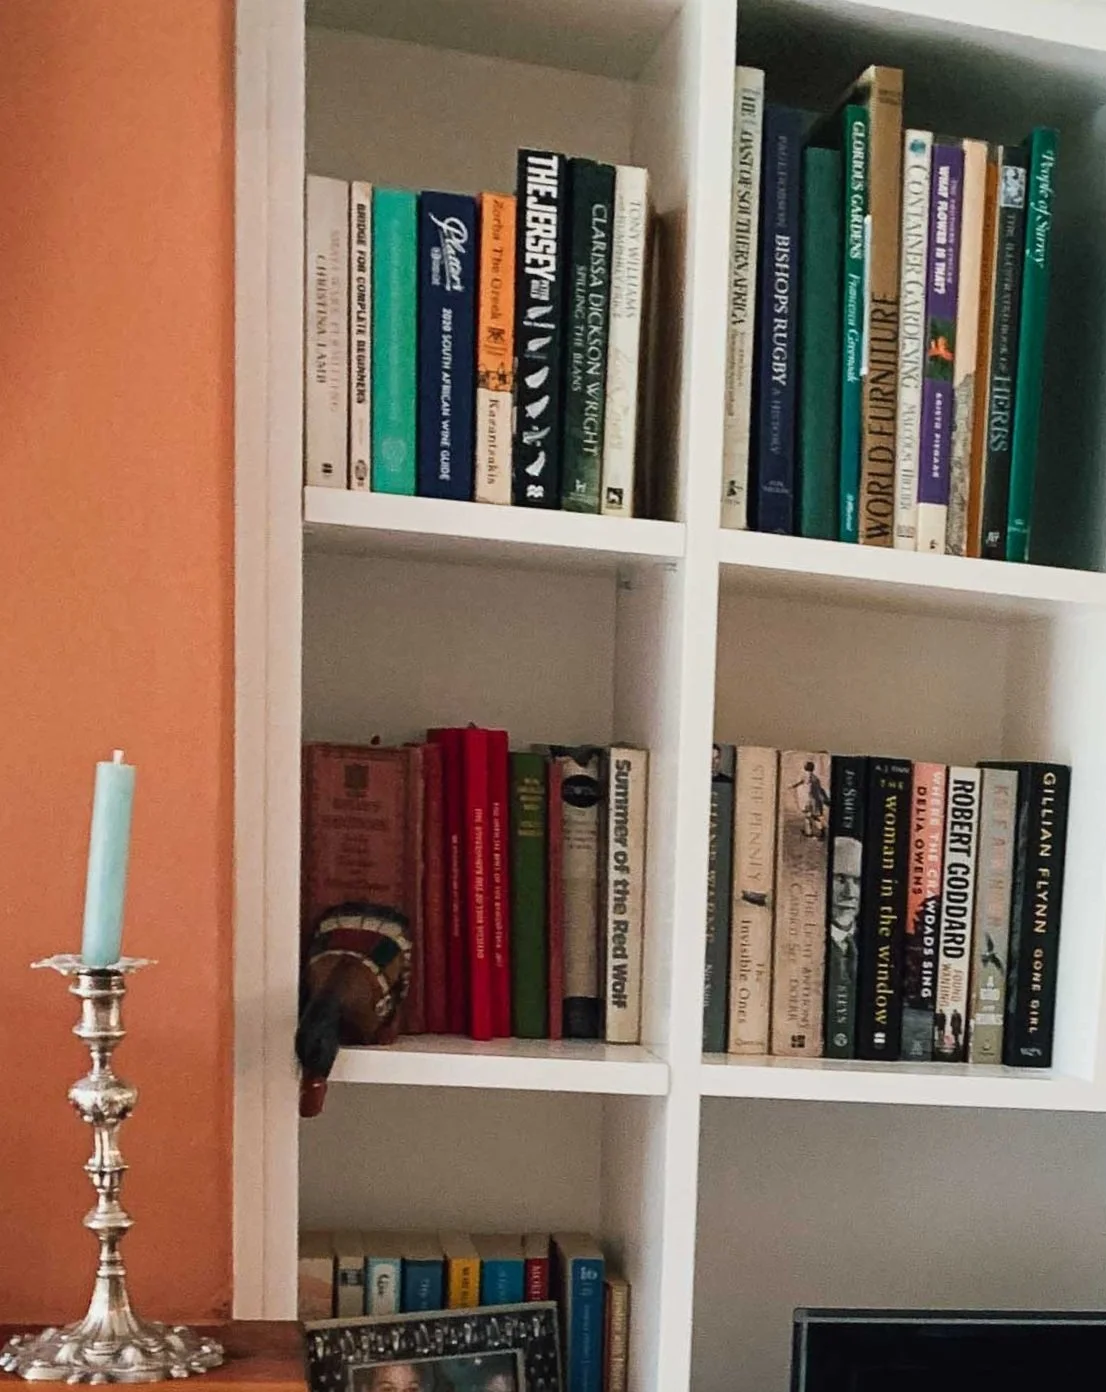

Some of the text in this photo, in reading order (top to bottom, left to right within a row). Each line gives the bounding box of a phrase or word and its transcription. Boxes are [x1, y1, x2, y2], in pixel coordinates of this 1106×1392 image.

[850, 120, 868, 191] GLORIOUS
[1025, 149, 1057, 268] People of Surrey
[489, 199, 506, 320] Zorba The Greek
[524, 154, 559, 283] THE JERSEY
[625, 202, 642, 319] TONY WILLIAMS
[735, 189, 756, 271] SOUTHERN
[772, 233, 791, 315] BISHOPS
[849, 193, 866, 260] GARDENS
[904, 164, 930, 276] CONTAINER
[933, 165, 950, 295] WHAT FLOWER IS THAT?
[356, 203, 366, 405] BRIDGE FOR COMPLETE BEGINNERS
[571, 264, 587, 393] SPILLING THE BEANS
[581, 203, 608, 458] CLARISSA DICKSON WRIGHT
[731, 272, 753, 325] AFRICA
[769, 318, 789, 386] RUGBY
[901, 280, 926, 389] GARDENING
[439, 308, 453, 481] 2020 SOUTH AFRICAN WINE GUIDE
[864, 291, 900, 541] WORLD FURNITURE
[989, 374, 1013, 452] HERBS
[842, 787, 856, 829] SMUTS
[911, 785, 928, 896] DELIA OWENS
[611, 759, 632, 1009] Summer of the Red Wolf
[873, 795, 900, 1025] woman in the window
[920, 771, 943, 999] WHERE THE CRAWDADS SING
[942, 779, 976, 960] ROBERT GODDARD
[1027, 772, 1057, 1034] GILLIAN FLYNN GONE GIRL
[738, 919, 753, 1024] Invisible Ones
[937, 962, 952, 1008] WANTING
[951, 969, 964, 1003] FOUND
